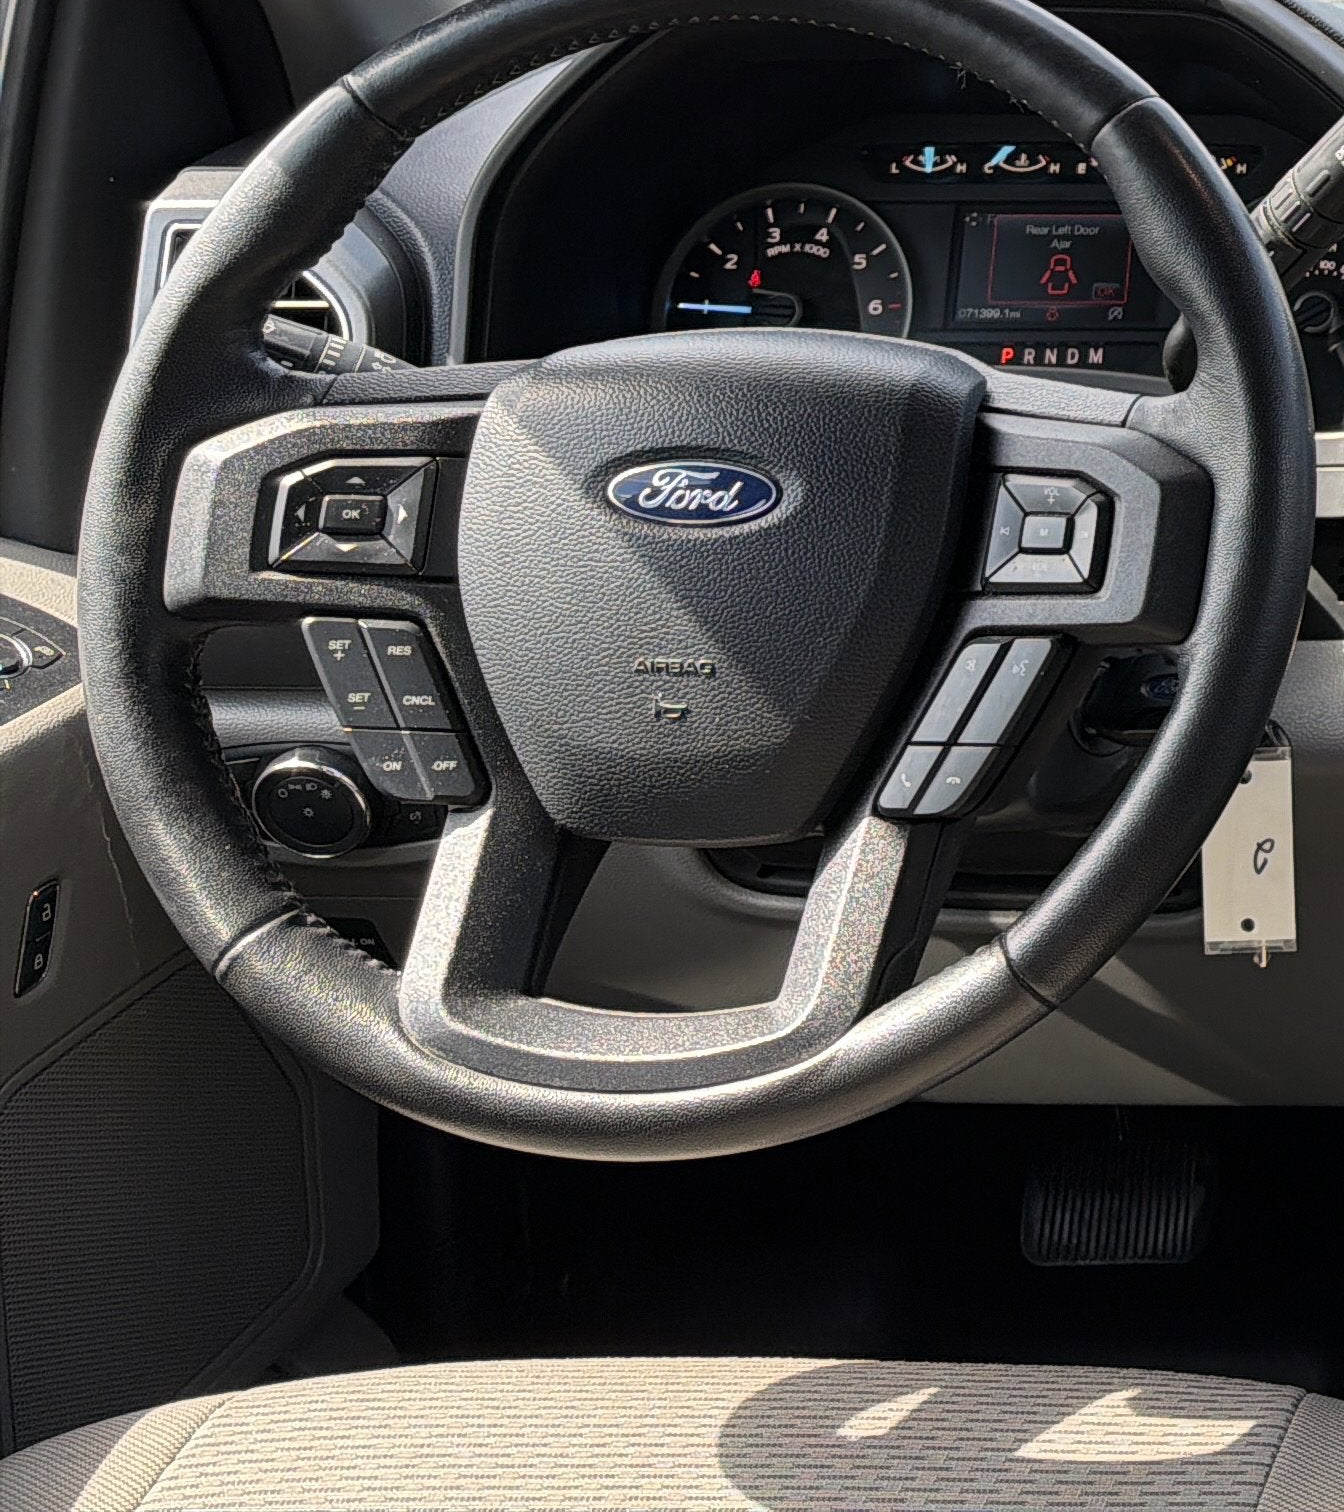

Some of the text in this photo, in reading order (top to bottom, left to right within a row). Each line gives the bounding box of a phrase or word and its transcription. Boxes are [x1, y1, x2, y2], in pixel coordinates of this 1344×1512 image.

[890, 163, 899, 174] L
[955, 163, 967, 174] H
[983, 163, 995, 175] C
[1050, 163, 1060, 174] H
[1075, 163, 1087, 174] E
[1026, 224, 1100, 235] Rear Left Door
[766, 228, 780, 243] 3
[814, 228, 829, 243] 4
[1050, 239, 1072, 250] Ajar
[766, 243, 830, 258] RPM X 1000
[723, 254, 738, 269] 2
[853, 254, 867, 269] 5
[868, 300, 883, 315] 6
[1001, 347, 1103, 365] P R N D M
[637, 468, 740, 512] Ford
[342, 508, 360, 521] OK
[328, 640, 351, 650] SET
[387, 646, 412, 655] RES
[633, 658, 716, 678] AIRBAG
[347, 692, 371, 703] SET
[403, 695, 436, 706] CNCL
[383, 761, 402, 771] ON
[432, 761, 458, 771] OFF
